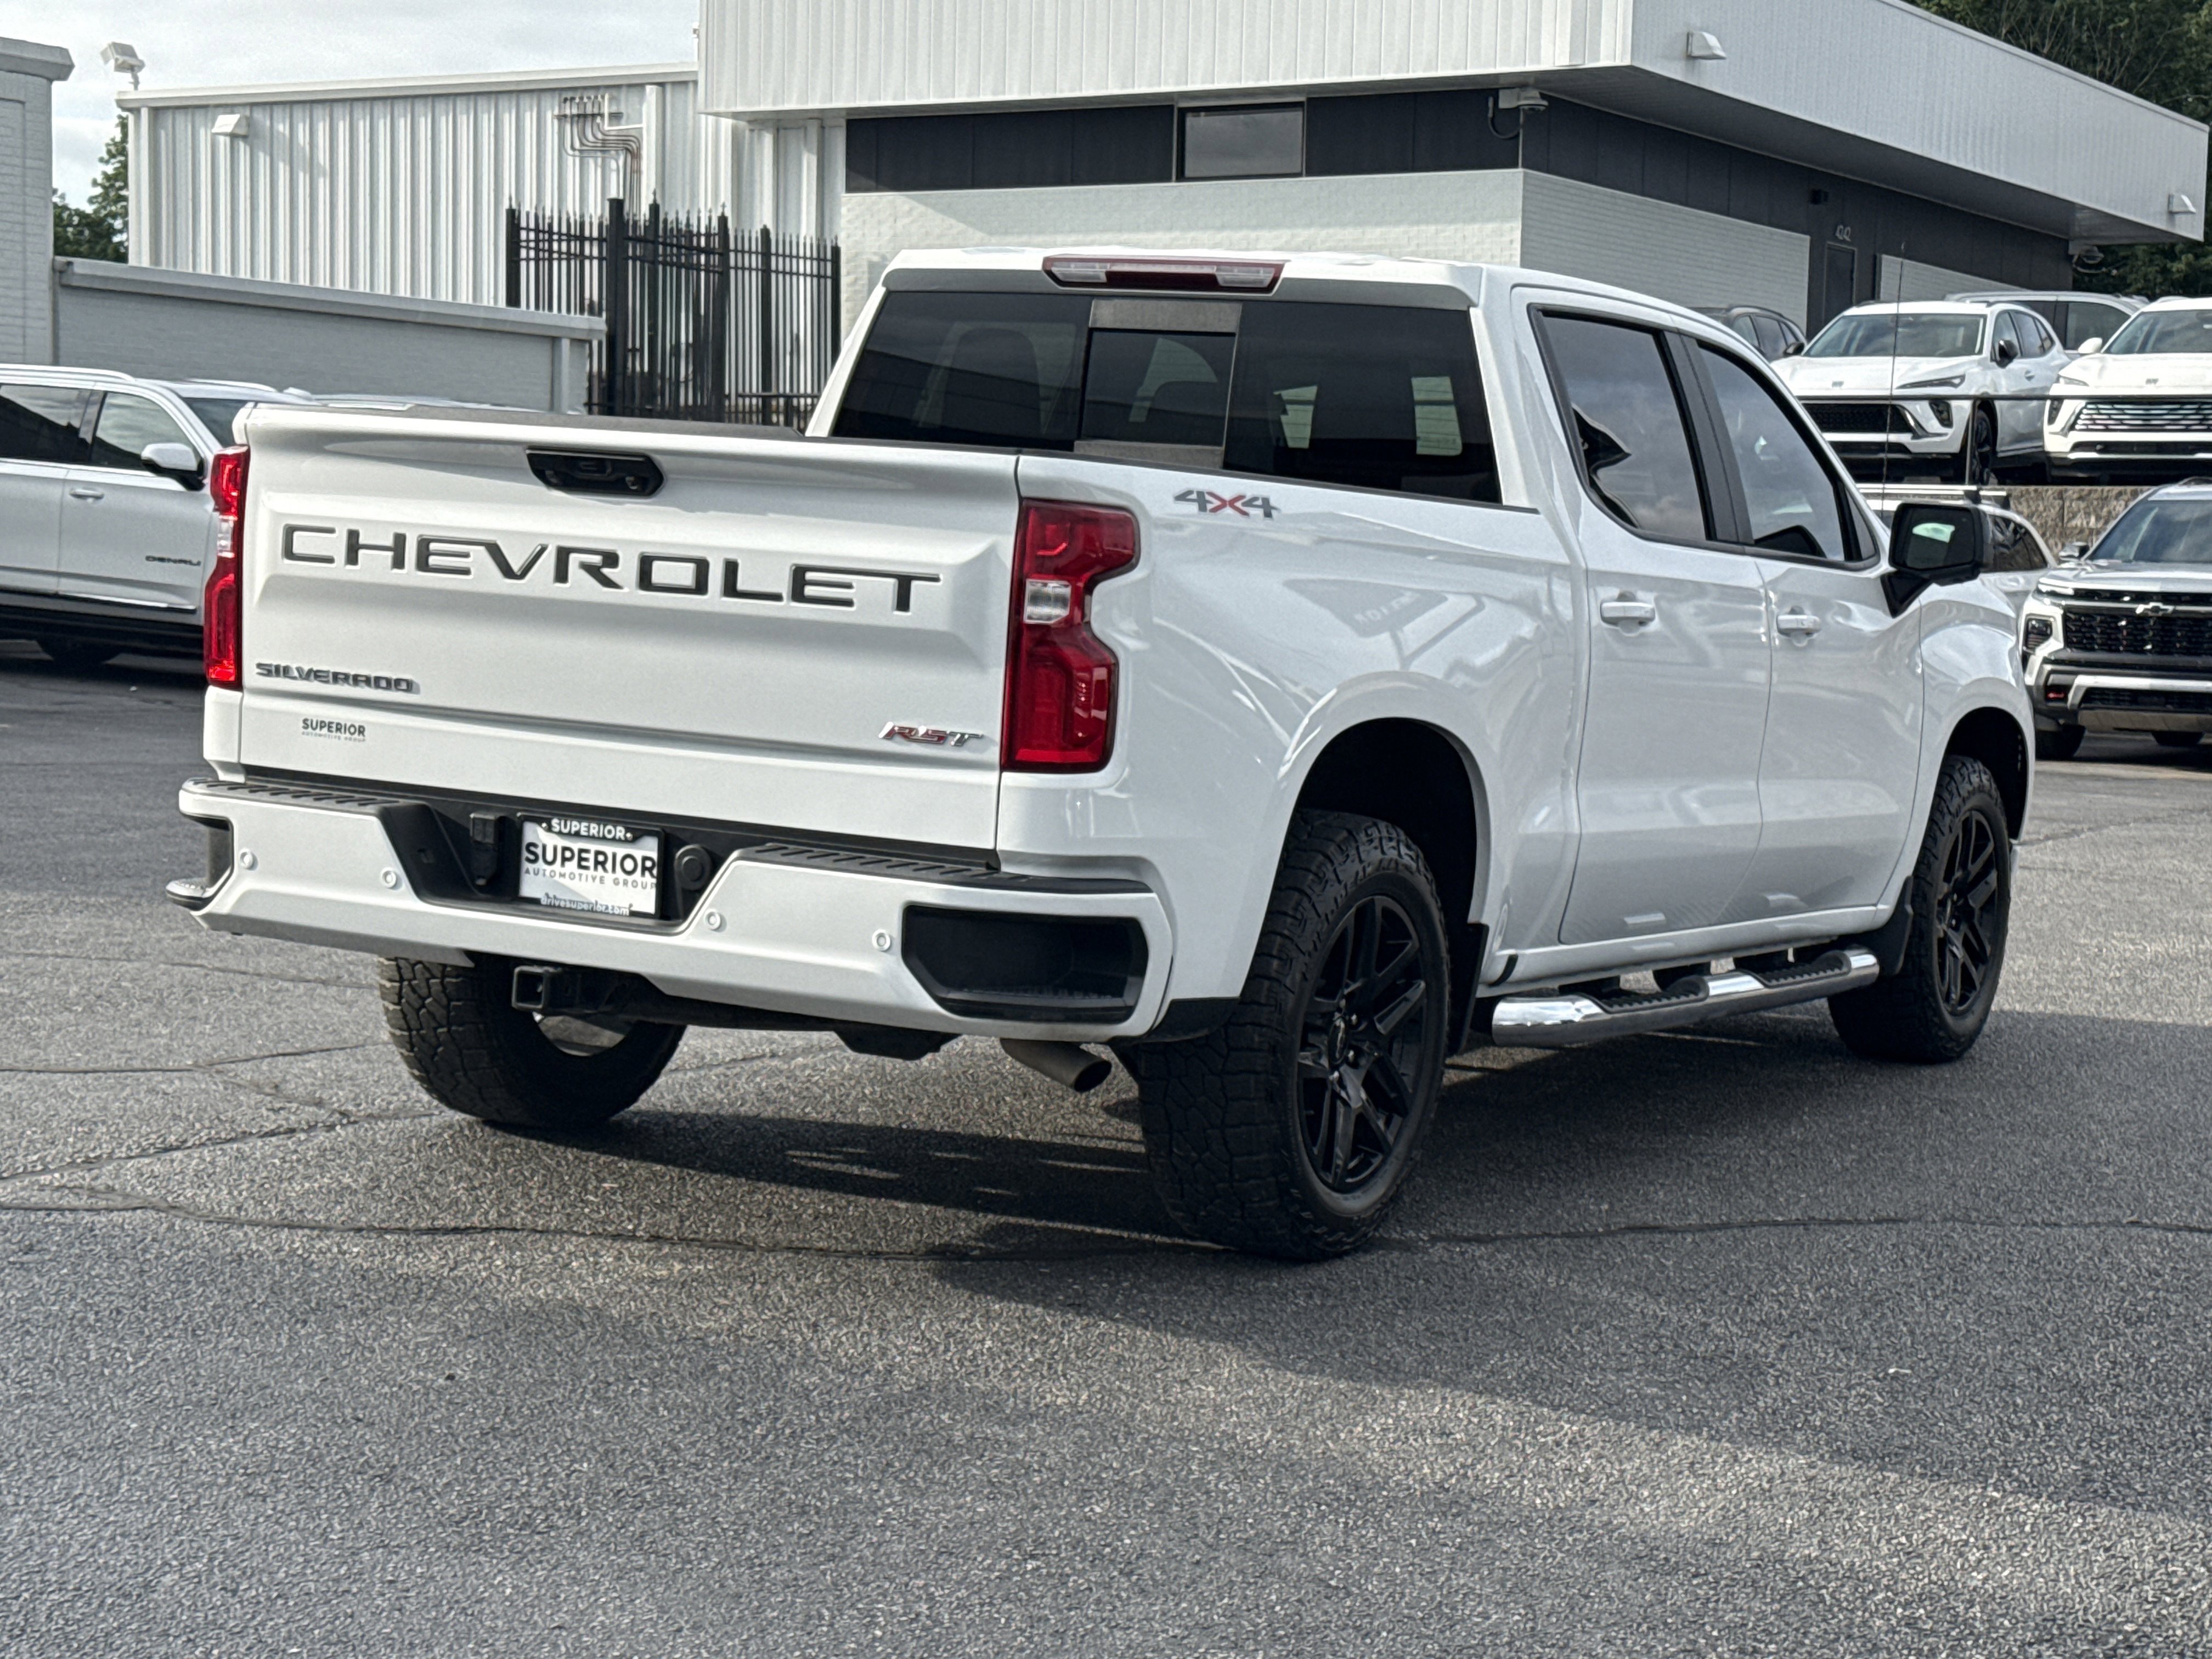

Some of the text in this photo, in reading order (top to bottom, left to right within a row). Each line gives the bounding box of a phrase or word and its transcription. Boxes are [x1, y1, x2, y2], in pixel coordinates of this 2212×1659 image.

[283, 523, 941, 613] CHEVROLET
[256, 662, 415, 693] SILVERADO
[302, 718, 366, 737] SUPERIOR
[878, 721, 984, 747] RST
[551, 819, 626, 840] SUPERIOR
[524, 842, 657, 879] SUPERIOR
[524, 867, 606, 885] AUTOMOTIVE
